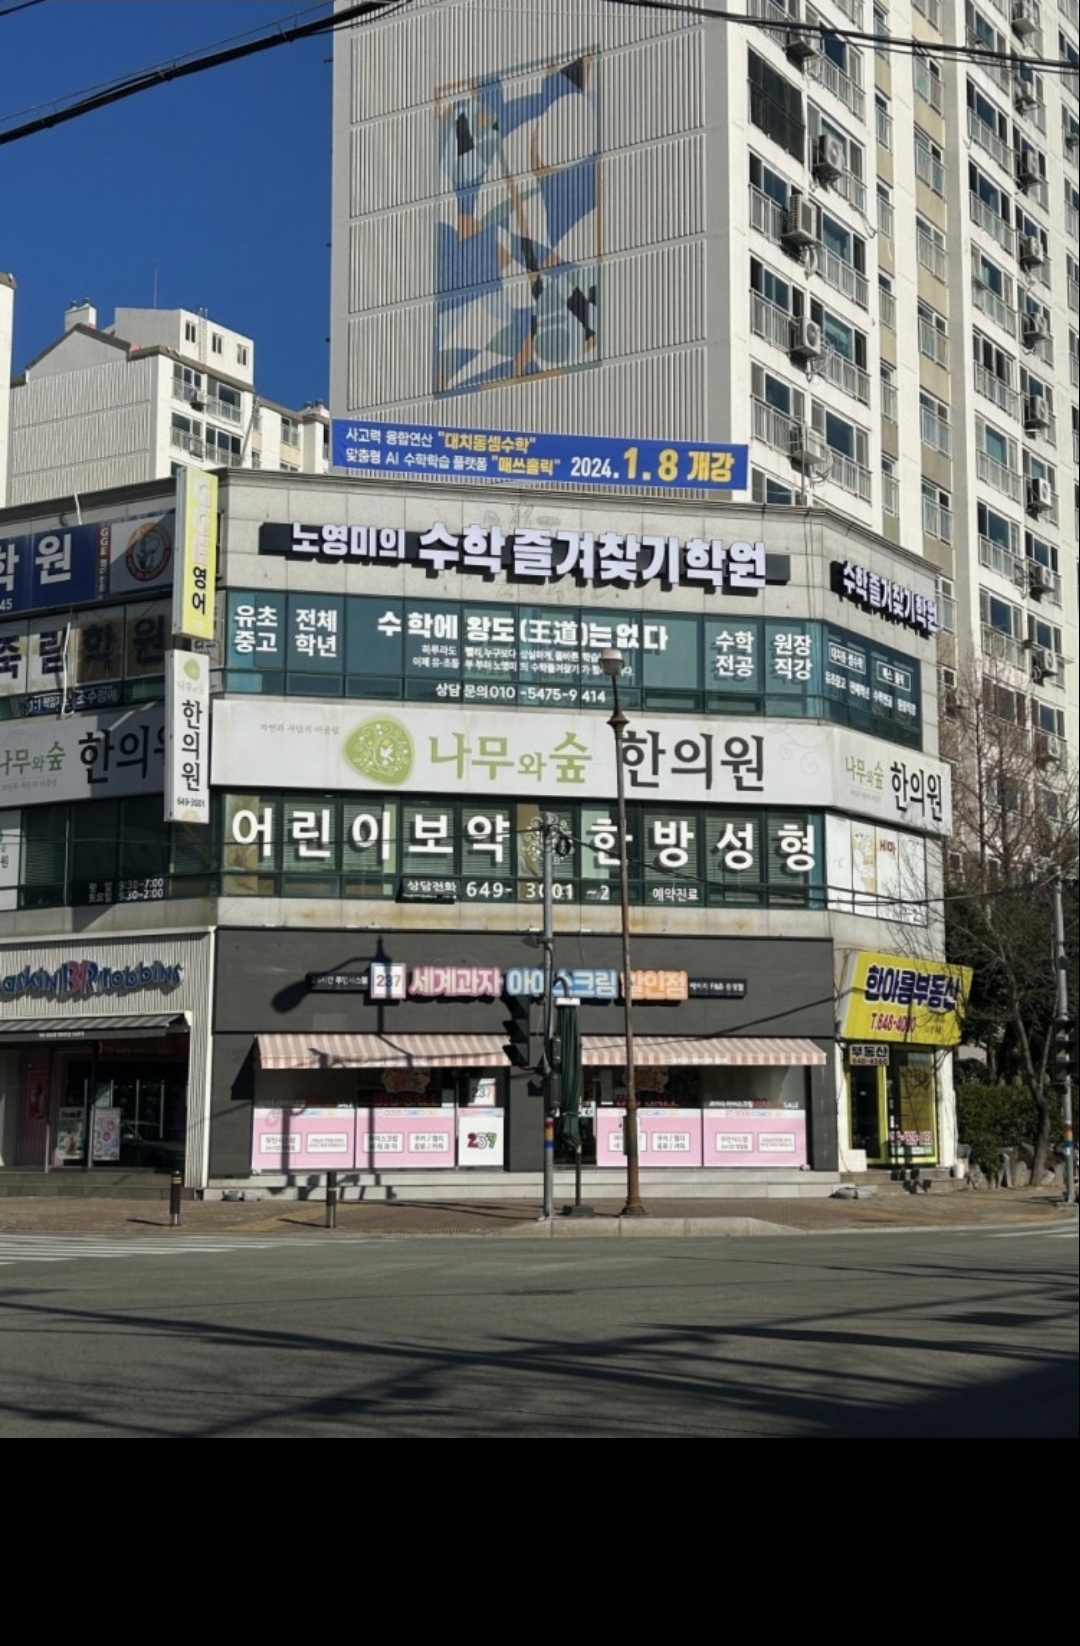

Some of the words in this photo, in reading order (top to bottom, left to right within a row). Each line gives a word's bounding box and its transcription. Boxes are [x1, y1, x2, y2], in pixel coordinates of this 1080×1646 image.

[346, 427, 381, 444] 사고력
[385, 430, 433, 448] 융합연산
[346, 447, 380, 464] 맞춤형
[385, 451, 399, 465] AI
[404, 452, 450, 470] 수학학습
[453, 455, 488, 472] 플랫폼
[570, 456, 619, 479] 2024.
[687, 450, 735, 483] 개강
[291, 521, 405, 558] 노영미의
[192, 566, 206, 615] 영어
[234, 604, 278, 629] 유초
[295, 608, 338, 634] 전체
[234, 630, 277, 654] 중고
[295, 633, 338, 658] 학년
[715, 630, 755, 655] 수학
[773, 632, 812, 658] 원장
[715, 655, 755, 679] 전공
[773, 657, 812, 682] 직강
[181, 699, 204, 792] 한의원
[429, 730, 594, 784] 나무와숲
[621, 728, 765, 792] 한의원
[890, 761, 943, 822] 한의원
[232, 806, 511, 863] 어린이보약
[590, 818, 816, 872] 한방성형
[407, 880, 457, 893] 상담전화
[652, 886, 699, 902] 예약진료
[376, 974, 402, 988] 237
[408, 966, 502, 996] 세계과자
[506, 967, 619, 999] 아이스크림
[865, 965, 961, 1011] 한아름부동산
[852, 1046, 887, 1058] 부동산
